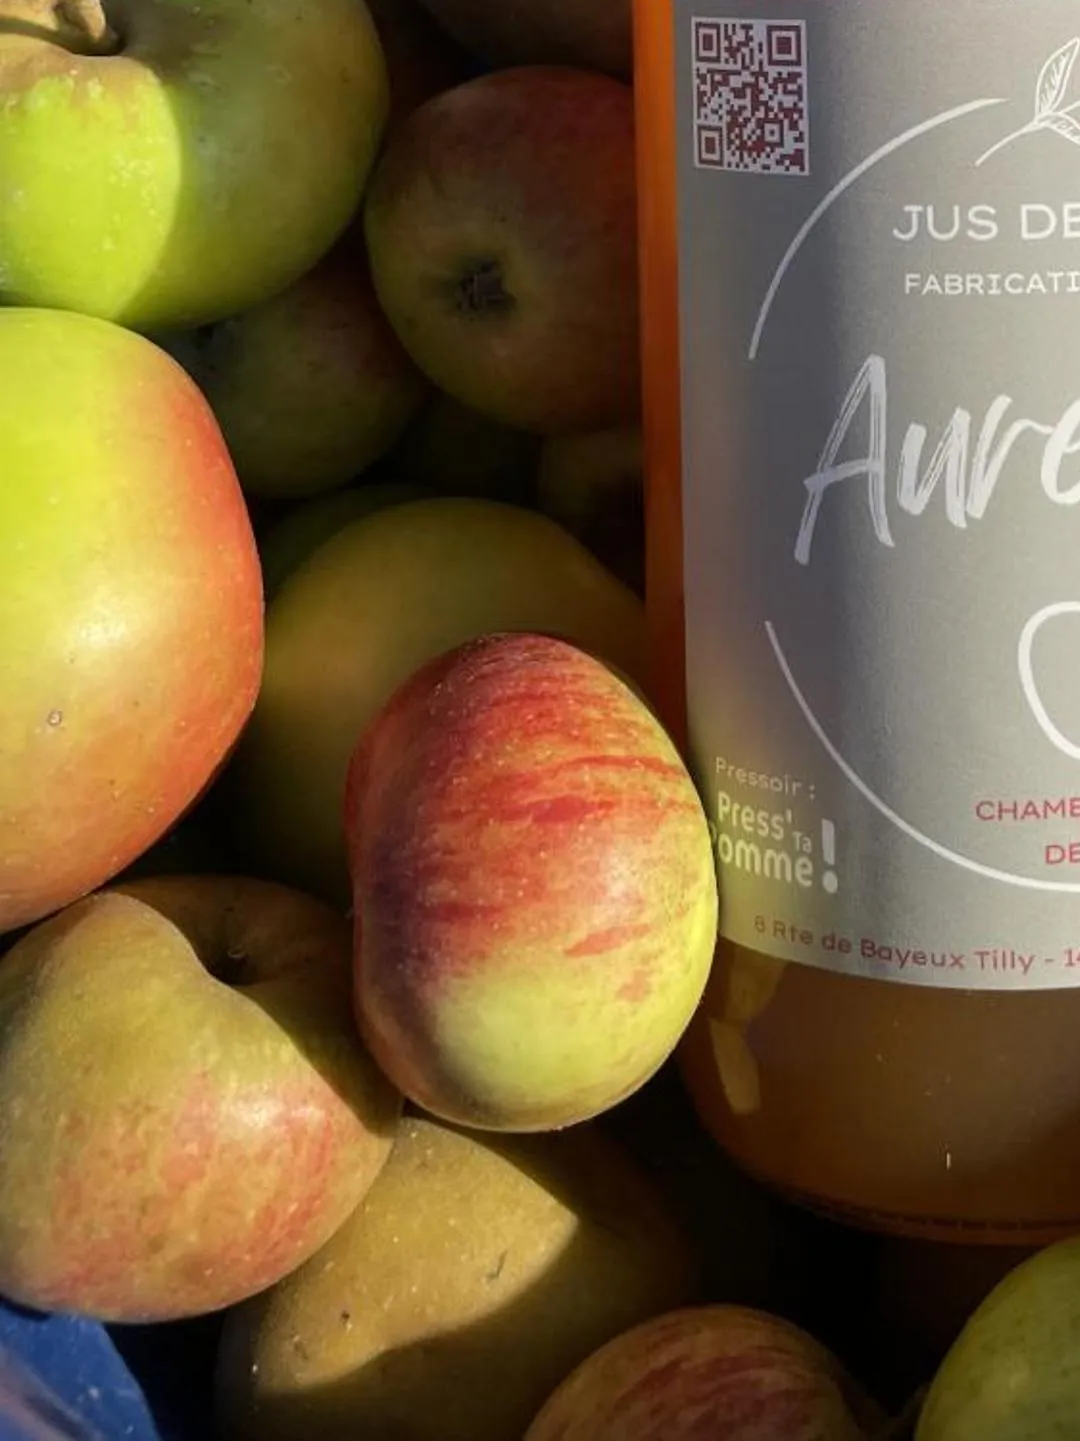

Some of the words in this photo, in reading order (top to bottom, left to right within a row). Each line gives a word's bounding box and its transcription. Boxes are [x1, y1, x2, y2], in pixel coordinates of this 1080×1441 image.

[892, 203, 999, 243] JUS
[717, 790, 793, 841] Press'
[793, 830, 812, 854] Ta
[773, 922, 813, 946] Rte
[821, 930, 853, 954] de
[860, 938, 965, 971] Bayeux
[974, 950, 1036, 974] Tilly
